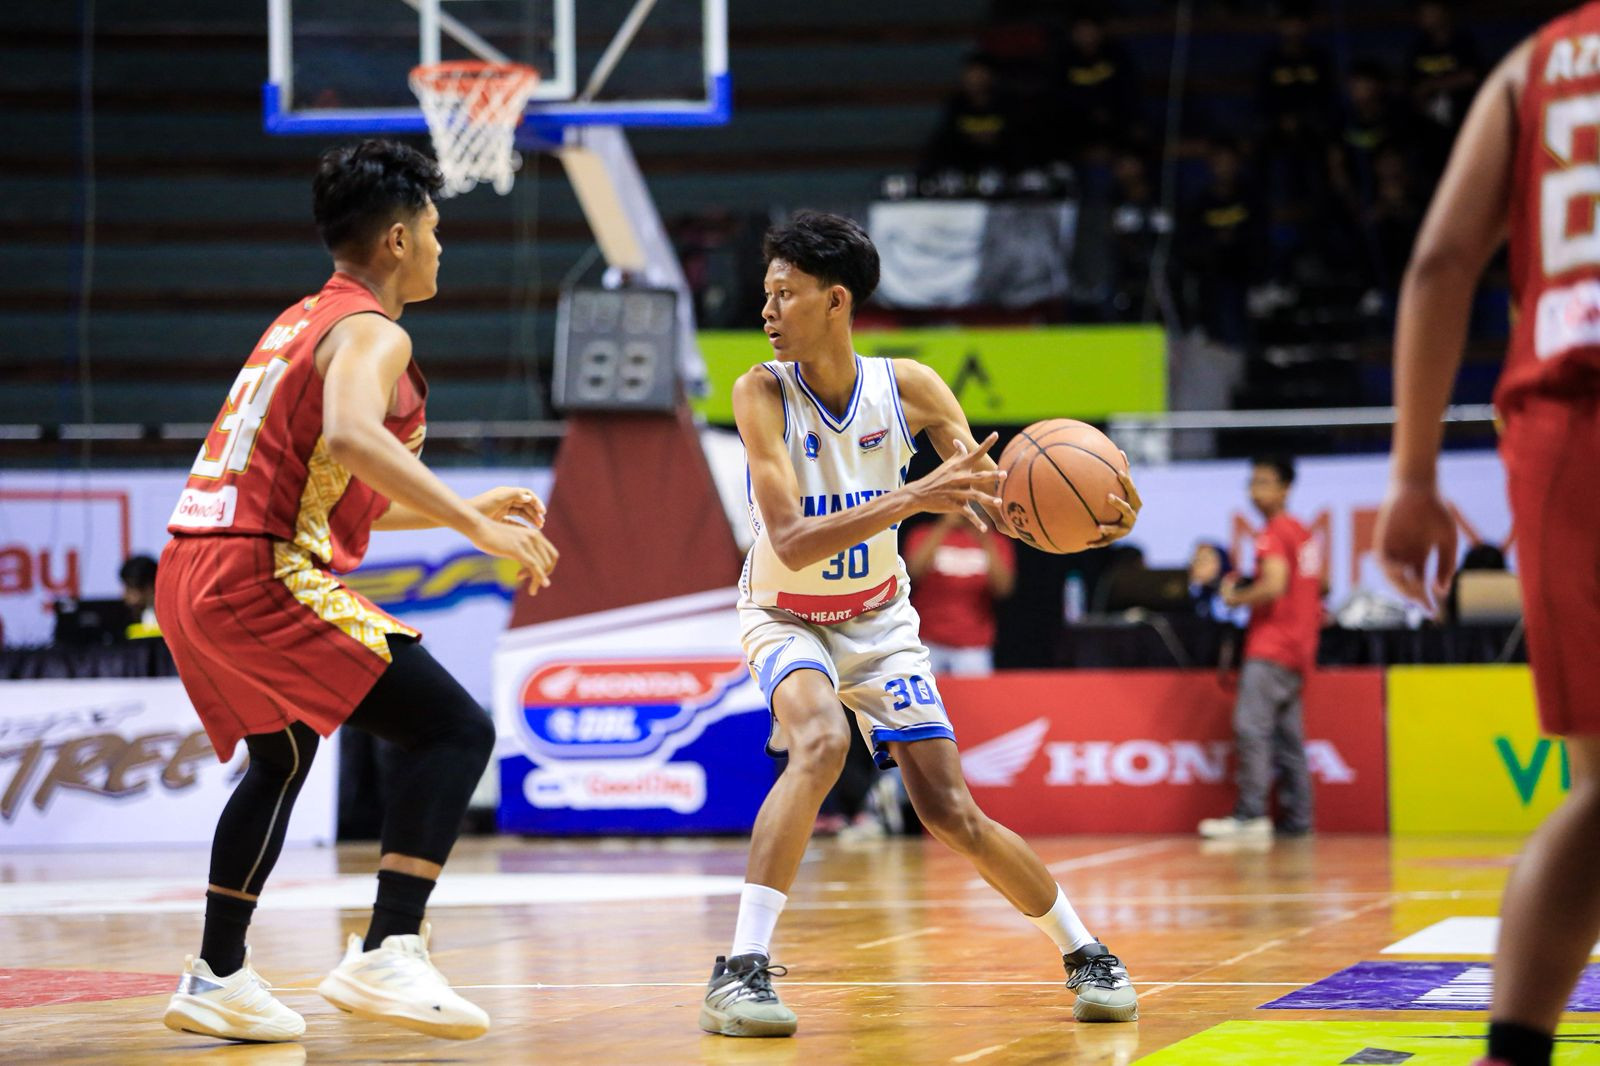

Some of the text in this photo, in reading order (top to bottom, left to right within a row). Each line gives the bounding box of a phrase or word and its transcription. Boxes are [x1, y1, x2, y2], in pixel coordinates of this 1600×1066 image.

[822, 542, 869, 580] 30
[884, 674, 936, 712] 30
[1044, 738, 1357, 786] HONA
